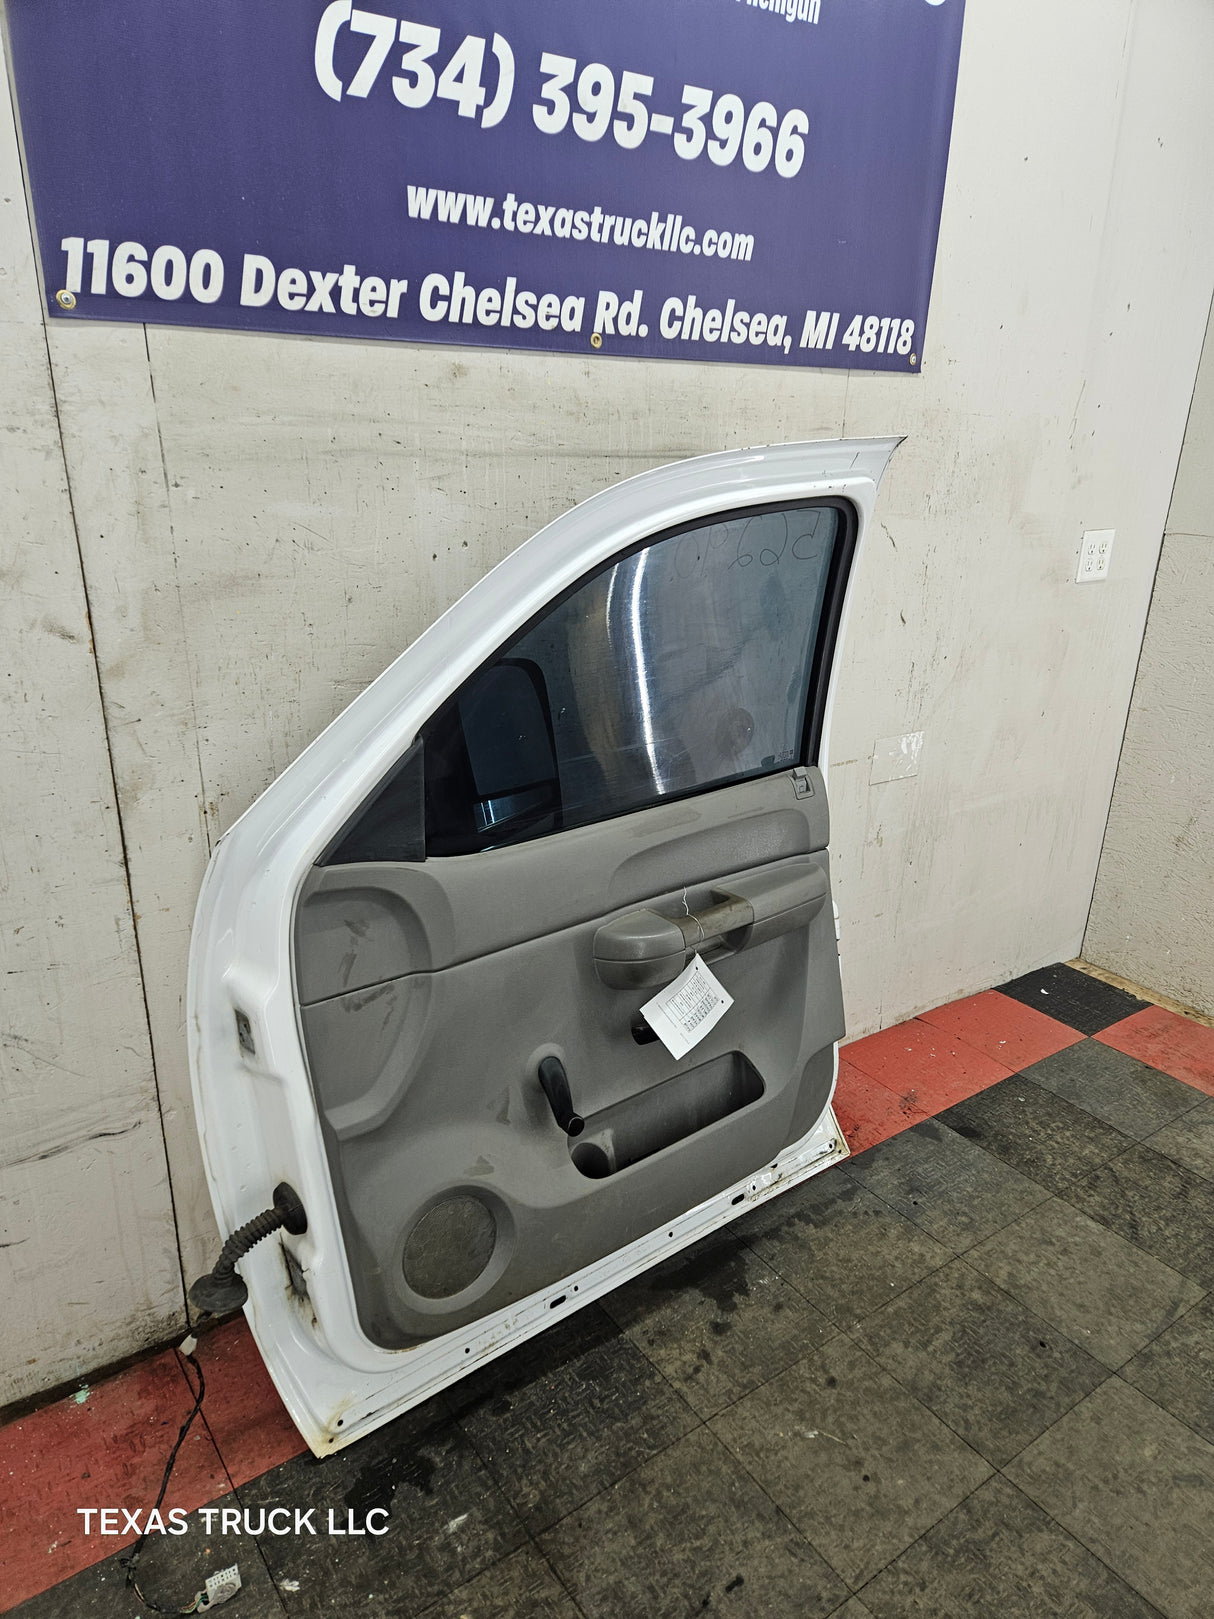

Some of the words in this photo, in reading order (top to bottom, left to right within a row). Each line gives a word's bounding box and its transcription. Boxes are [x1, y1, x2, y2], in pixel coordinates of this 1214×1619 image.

[314, 0, 515, 128] (734)
[532, 52, 809, 178] 395-3966
[407, 185, 755, 261] www.texastruckllc.com
[61, 236, 225, 304] 11600
[240, 253, 408, 318] Dexter
[419, 271, 586, 333] Chelsea
[595, 289, 648, 338] Rd.
[659, 295, 792, 354] Chelsea,
[800, 310, 839, 349] MI
[842, 314, 914, 354] 48118
